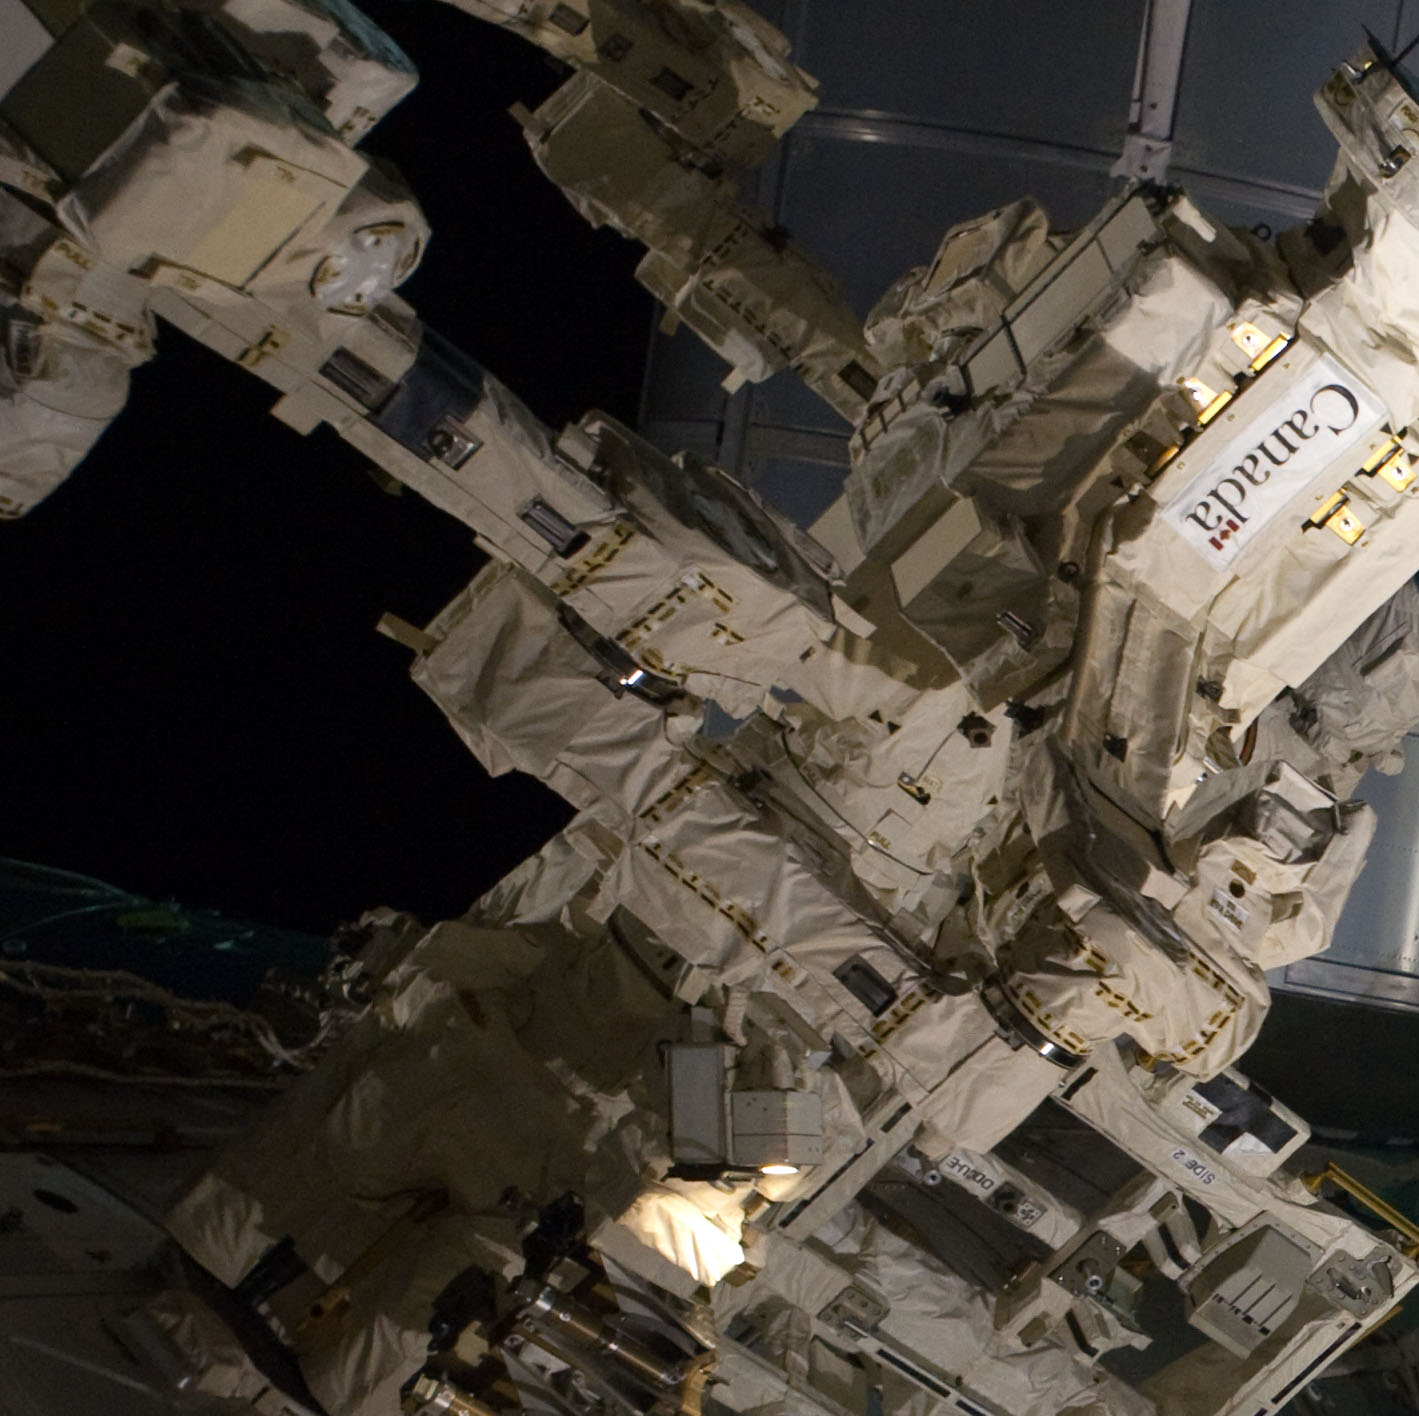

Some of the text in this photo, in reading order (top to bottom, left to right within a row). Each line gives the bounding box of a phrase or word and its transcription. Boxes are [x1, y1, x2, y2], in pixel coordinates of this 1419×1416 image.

[1185, 383, 1360, 531] Canada
[1172, 1149, 1216, 1185] SIDE 2
